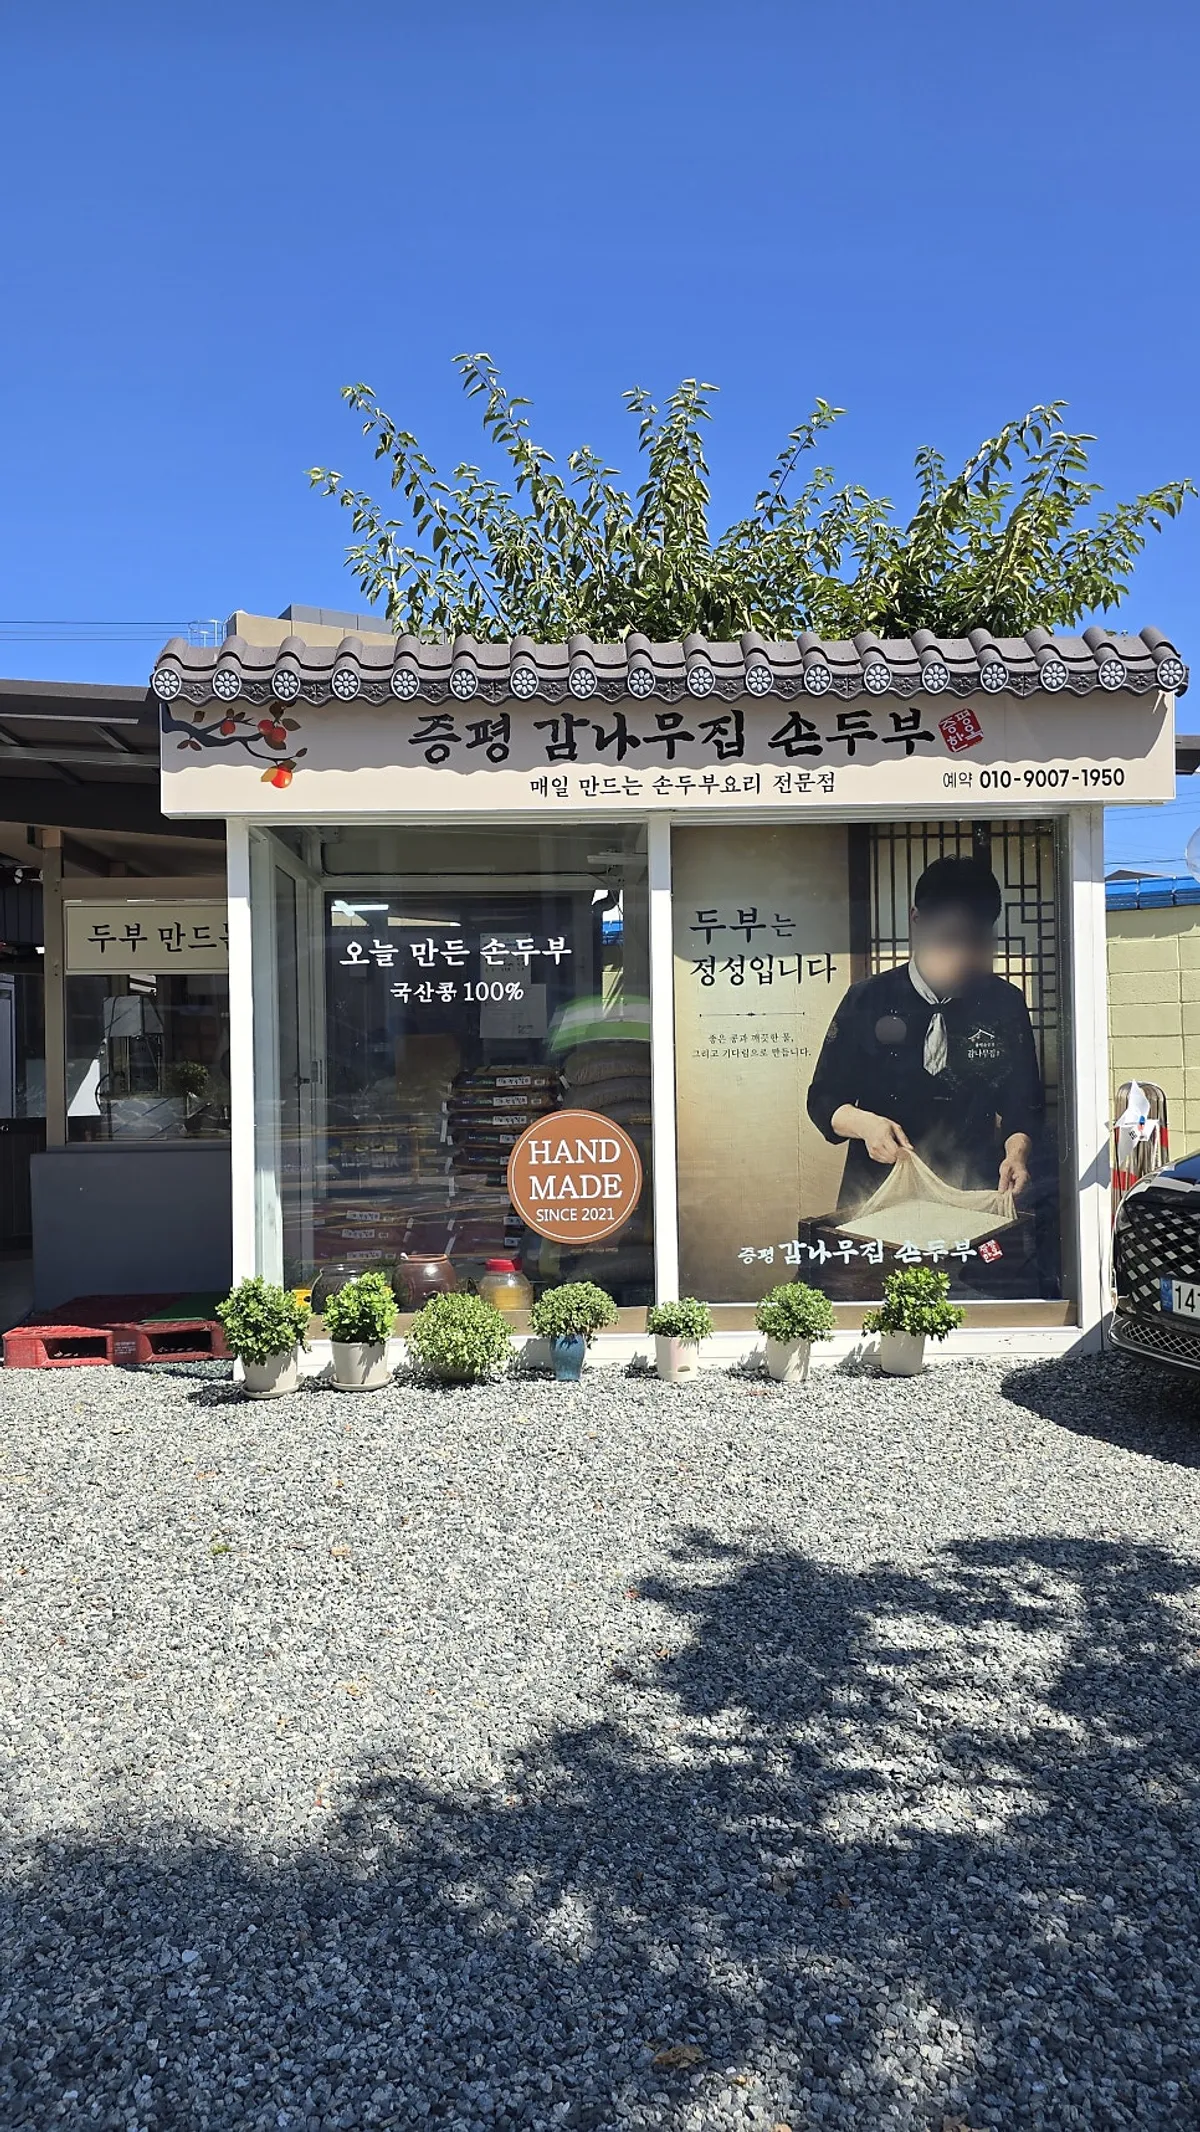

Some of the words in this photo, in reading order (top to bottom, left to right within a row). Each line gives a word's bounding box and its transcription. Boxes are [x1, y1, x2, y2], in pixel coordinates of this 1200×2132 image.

[408, 712, 511, 764] 증평
[533, 709, 745, 762] 감나무집
[767, 707, 936, 757] 손두부
[530, 775, 569, 798] 매일
[579, 774, 643, 797] 만드는
[652, 772, 761, 796] 손두부요리
[773, 771, 835, 794] 전문점
[942, 771, 973, 789] 예약
[979, 768, 1125, 789] 010-9007-1950
[88, 922, 148, 953] 두부
[689, 907, 796, 945] 두부는
[339, 939, 399, 967] 오늘
[409, 938, 470, 967] 만든
[480, 936, 573, 967] 손두부
[690, 952, 838, 987] 정성입니다
[390, 981, 458, 1004] 국산콩
[463, 981, 525, 1001] 100%
[692, 1049, 719, 1059] 그리고
[722, 1048, 769, 1058] 기다림으로
[528, 1139, 621, 1165] HAND
[529, 1173, 623, 1200] MADE
[536, 1208, 578, 1222] SINCE
[582, 1207, 615, 1221] 2021
[737, 1246, 774, 1265] 증평
[778, 1239, 884, 1265] 감나무집
[894, 1239, 977, 1264] 손두부
[1175, 1285, 1200, 1313] 14
